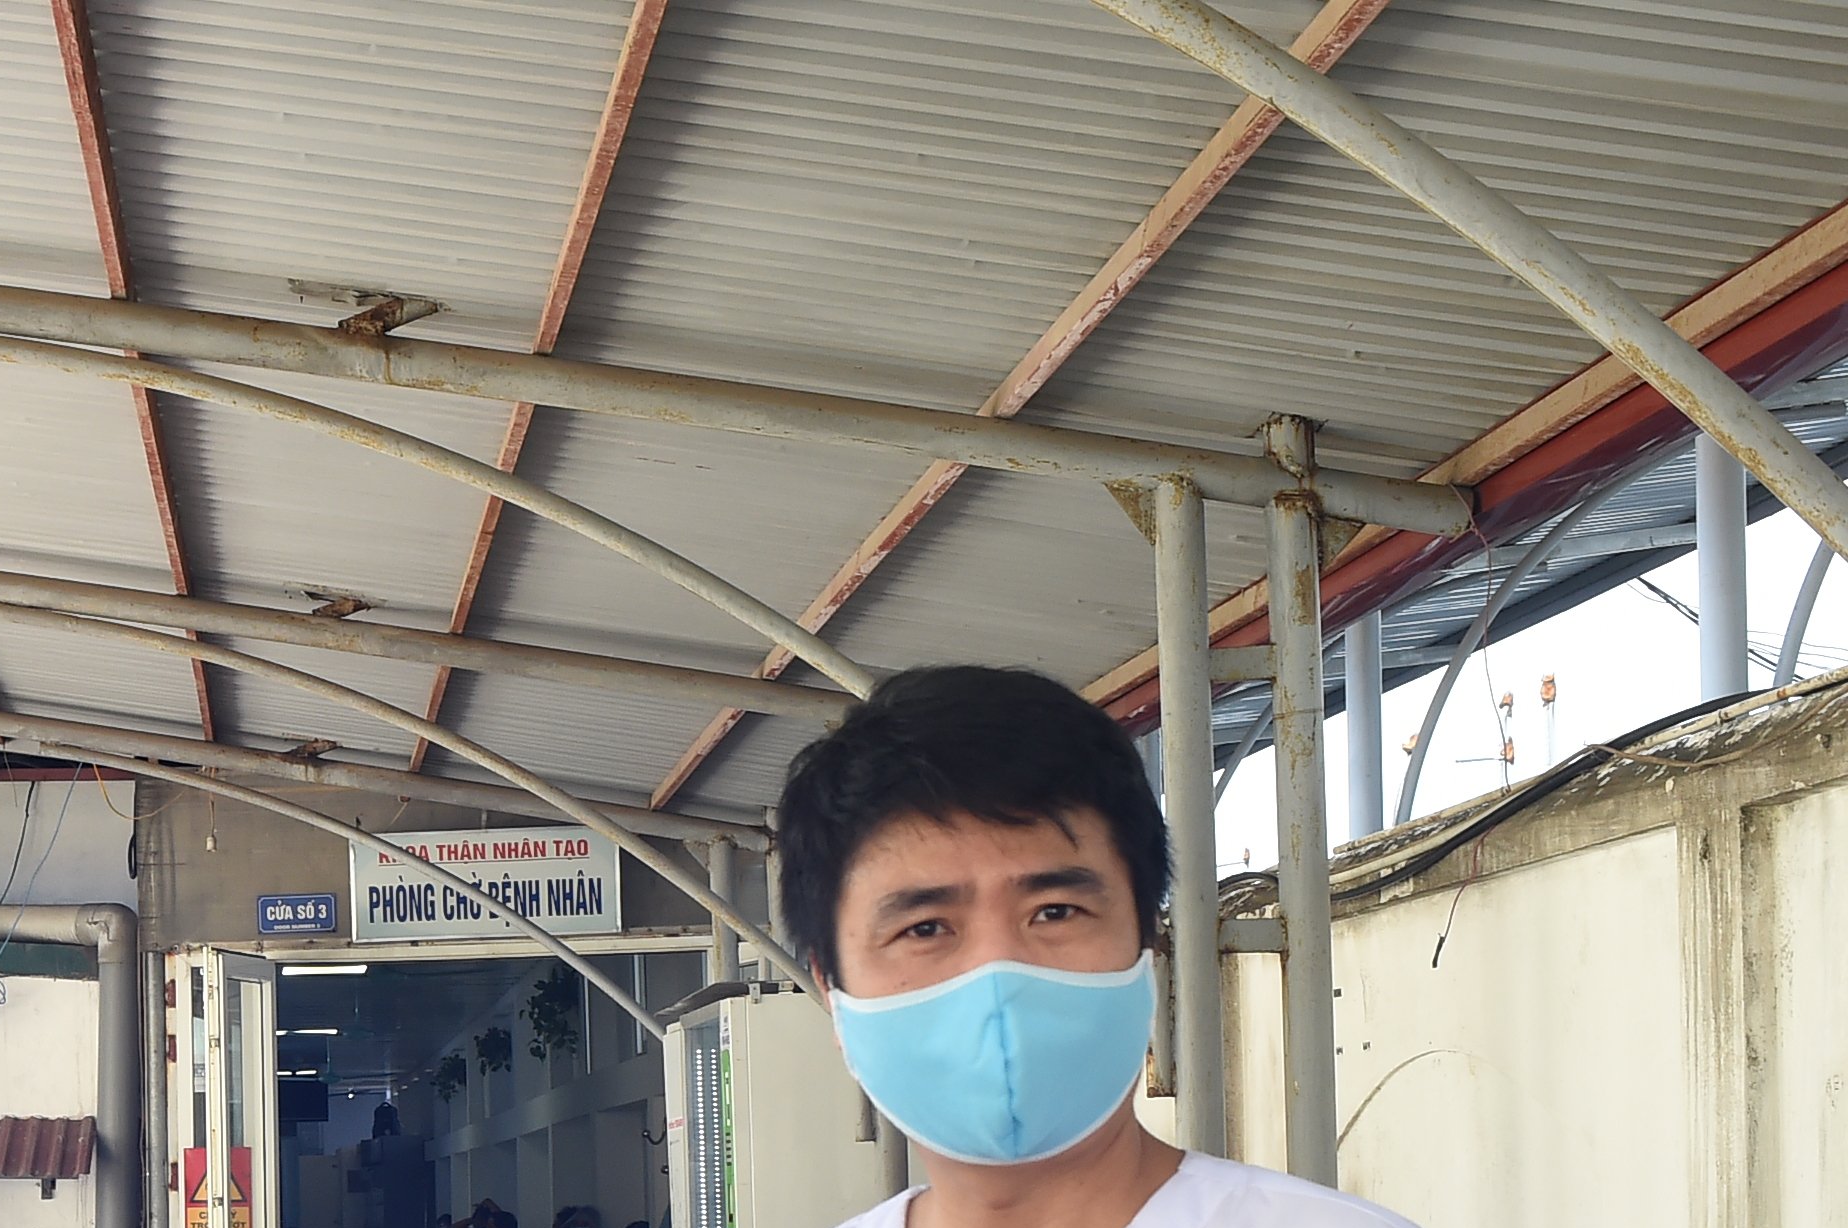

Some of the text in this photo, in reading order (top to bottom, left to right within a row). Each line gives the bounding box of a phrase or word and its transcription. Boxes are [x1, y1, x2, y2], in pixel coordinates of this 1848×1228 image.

[436, 839, 486, 864] THẬN
[493, 838, 546, 859] NHÂN
[553, 839, 589, 861] TẠO
[368, 875, 436, 924] PHÒNG
[547, 869, 602, 917] NHÂN
[266, 899, 327, 921] CỬA SỐ 3
